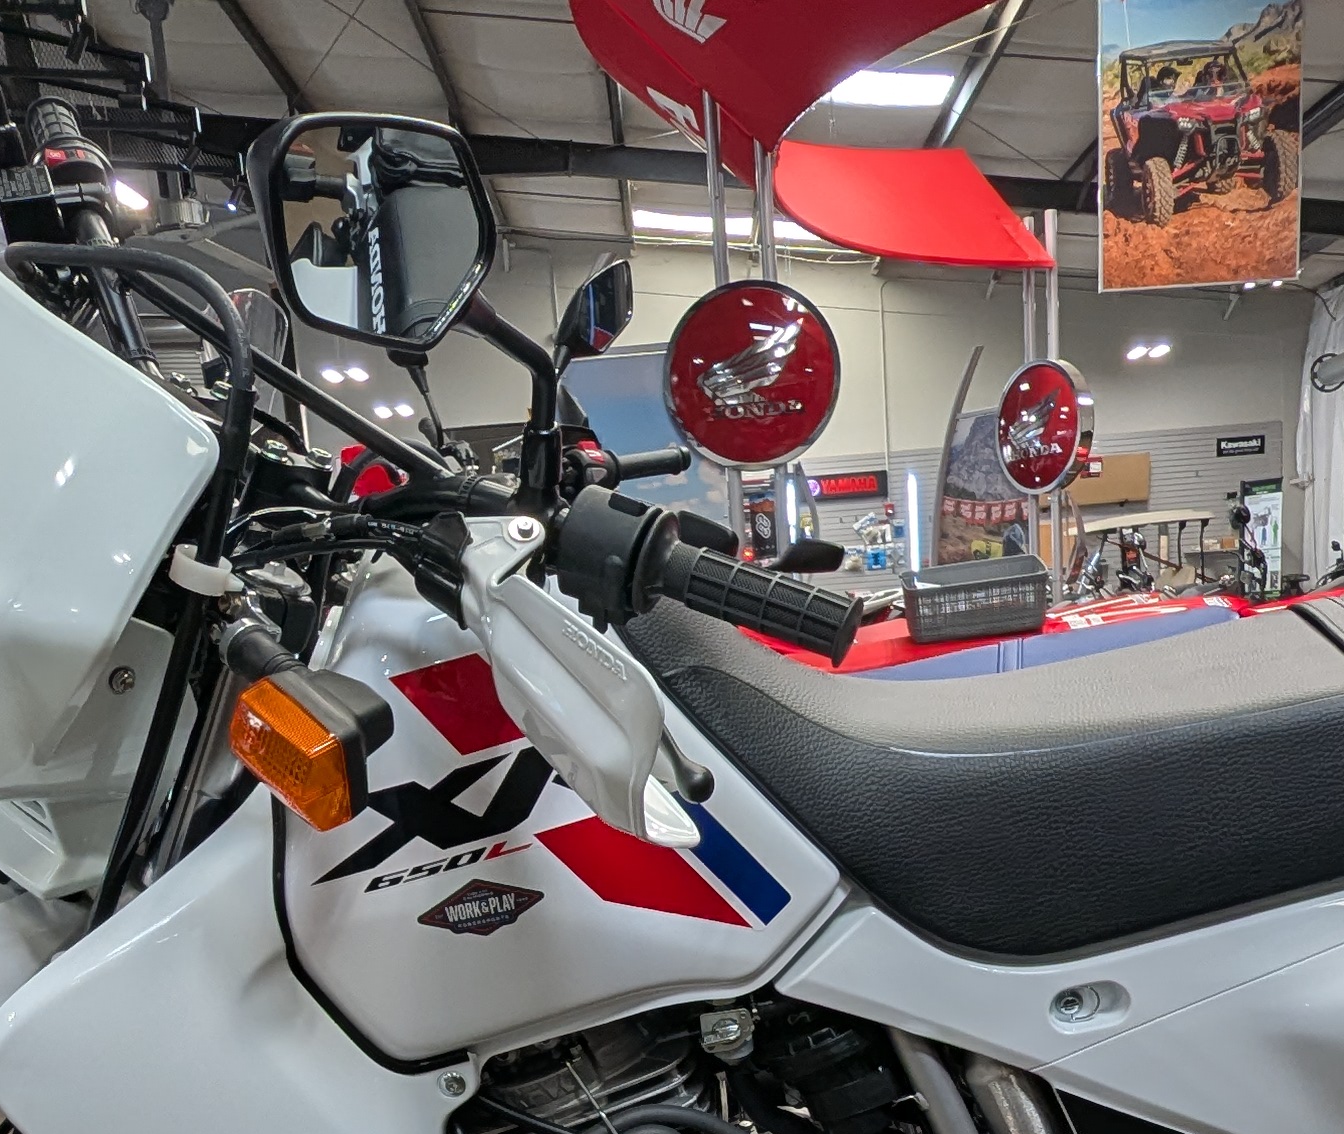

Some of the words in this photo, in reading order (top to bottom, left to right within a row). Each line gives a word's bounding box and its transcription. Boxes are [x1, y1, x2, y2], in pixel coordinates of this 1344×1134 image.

[821, 475, 878, 495] YAMAHA
[364, 840, 533, 893] 650L
[444, 892, 516, 923] WORK&PLAY
